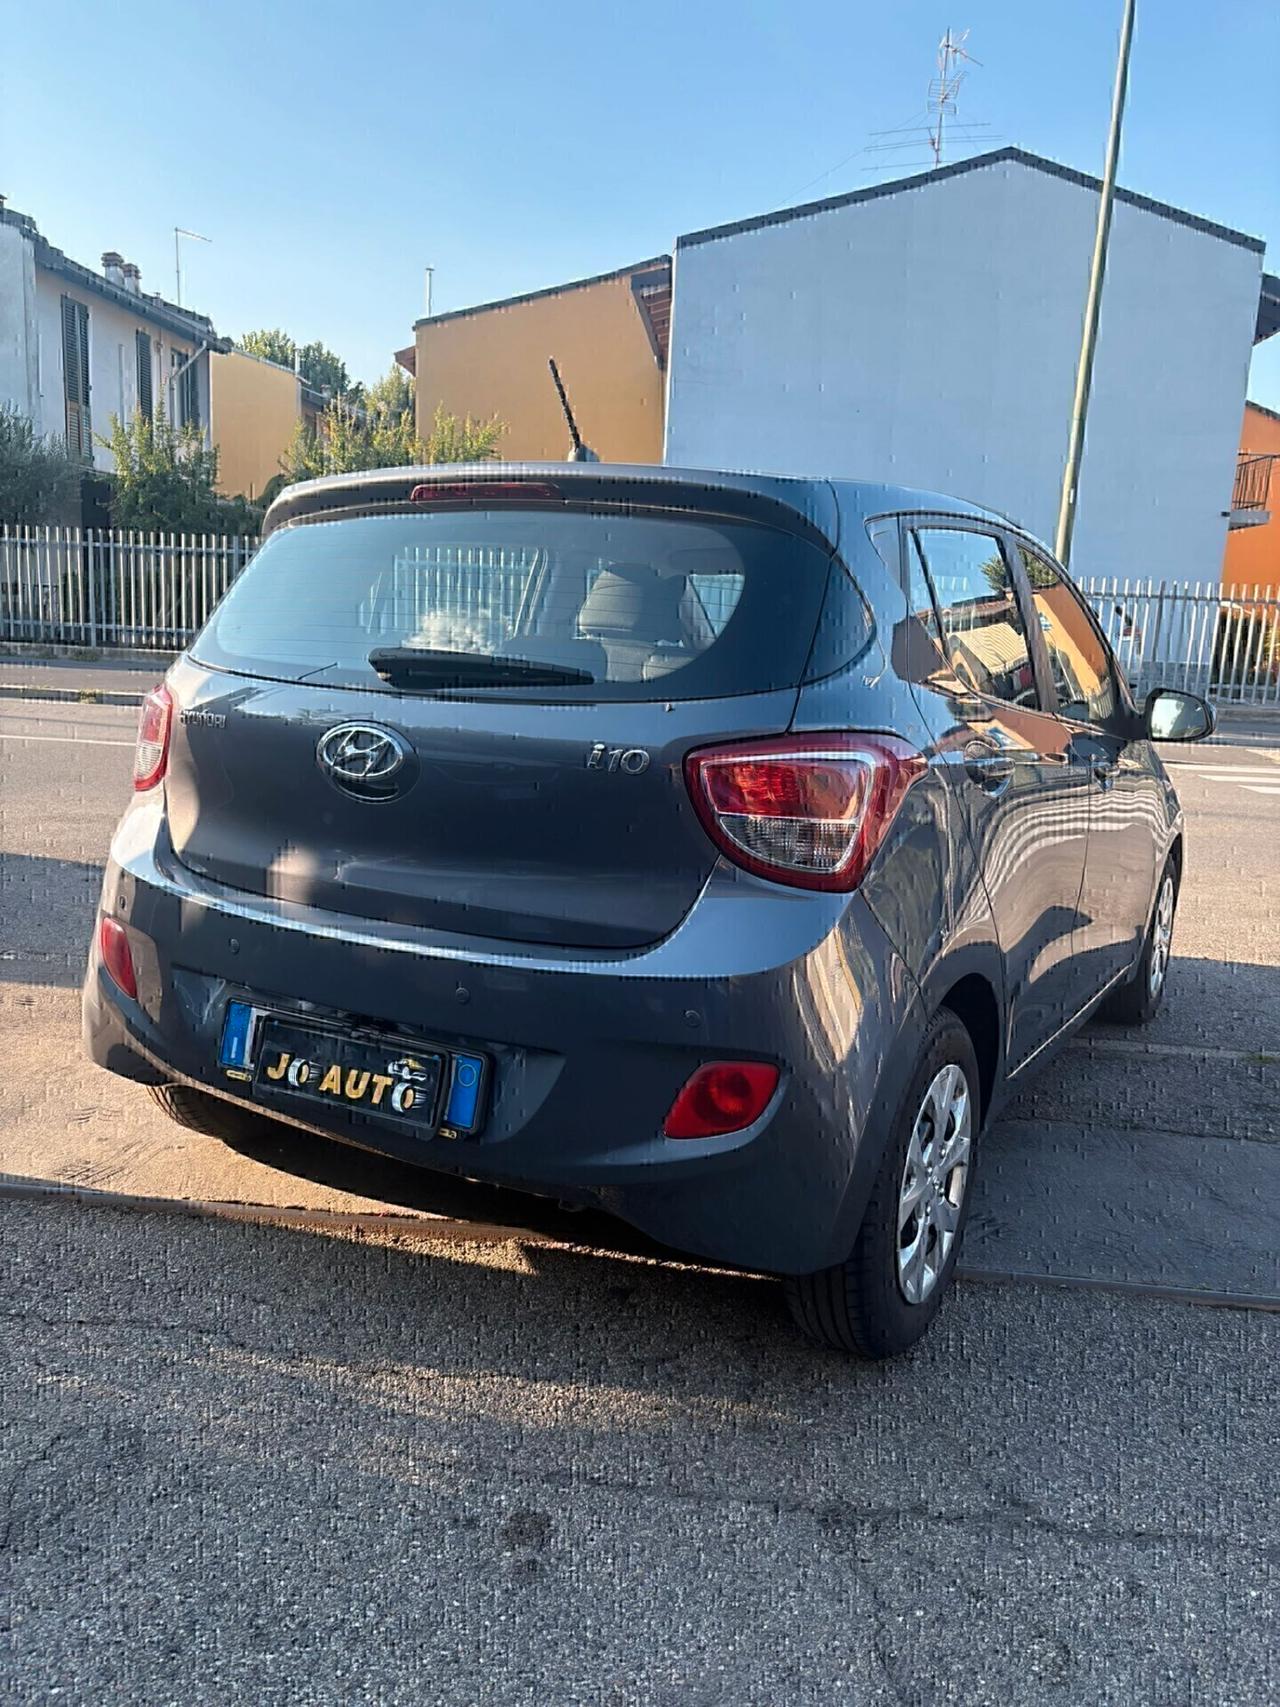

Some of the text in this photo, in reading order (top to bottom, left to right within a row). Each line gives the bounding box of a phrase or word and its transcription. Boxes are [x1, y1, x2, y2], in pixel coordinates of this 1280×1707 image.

[587, 743, 650, 774] i10
[267, 1052, 416, 1113] JO AUTO
